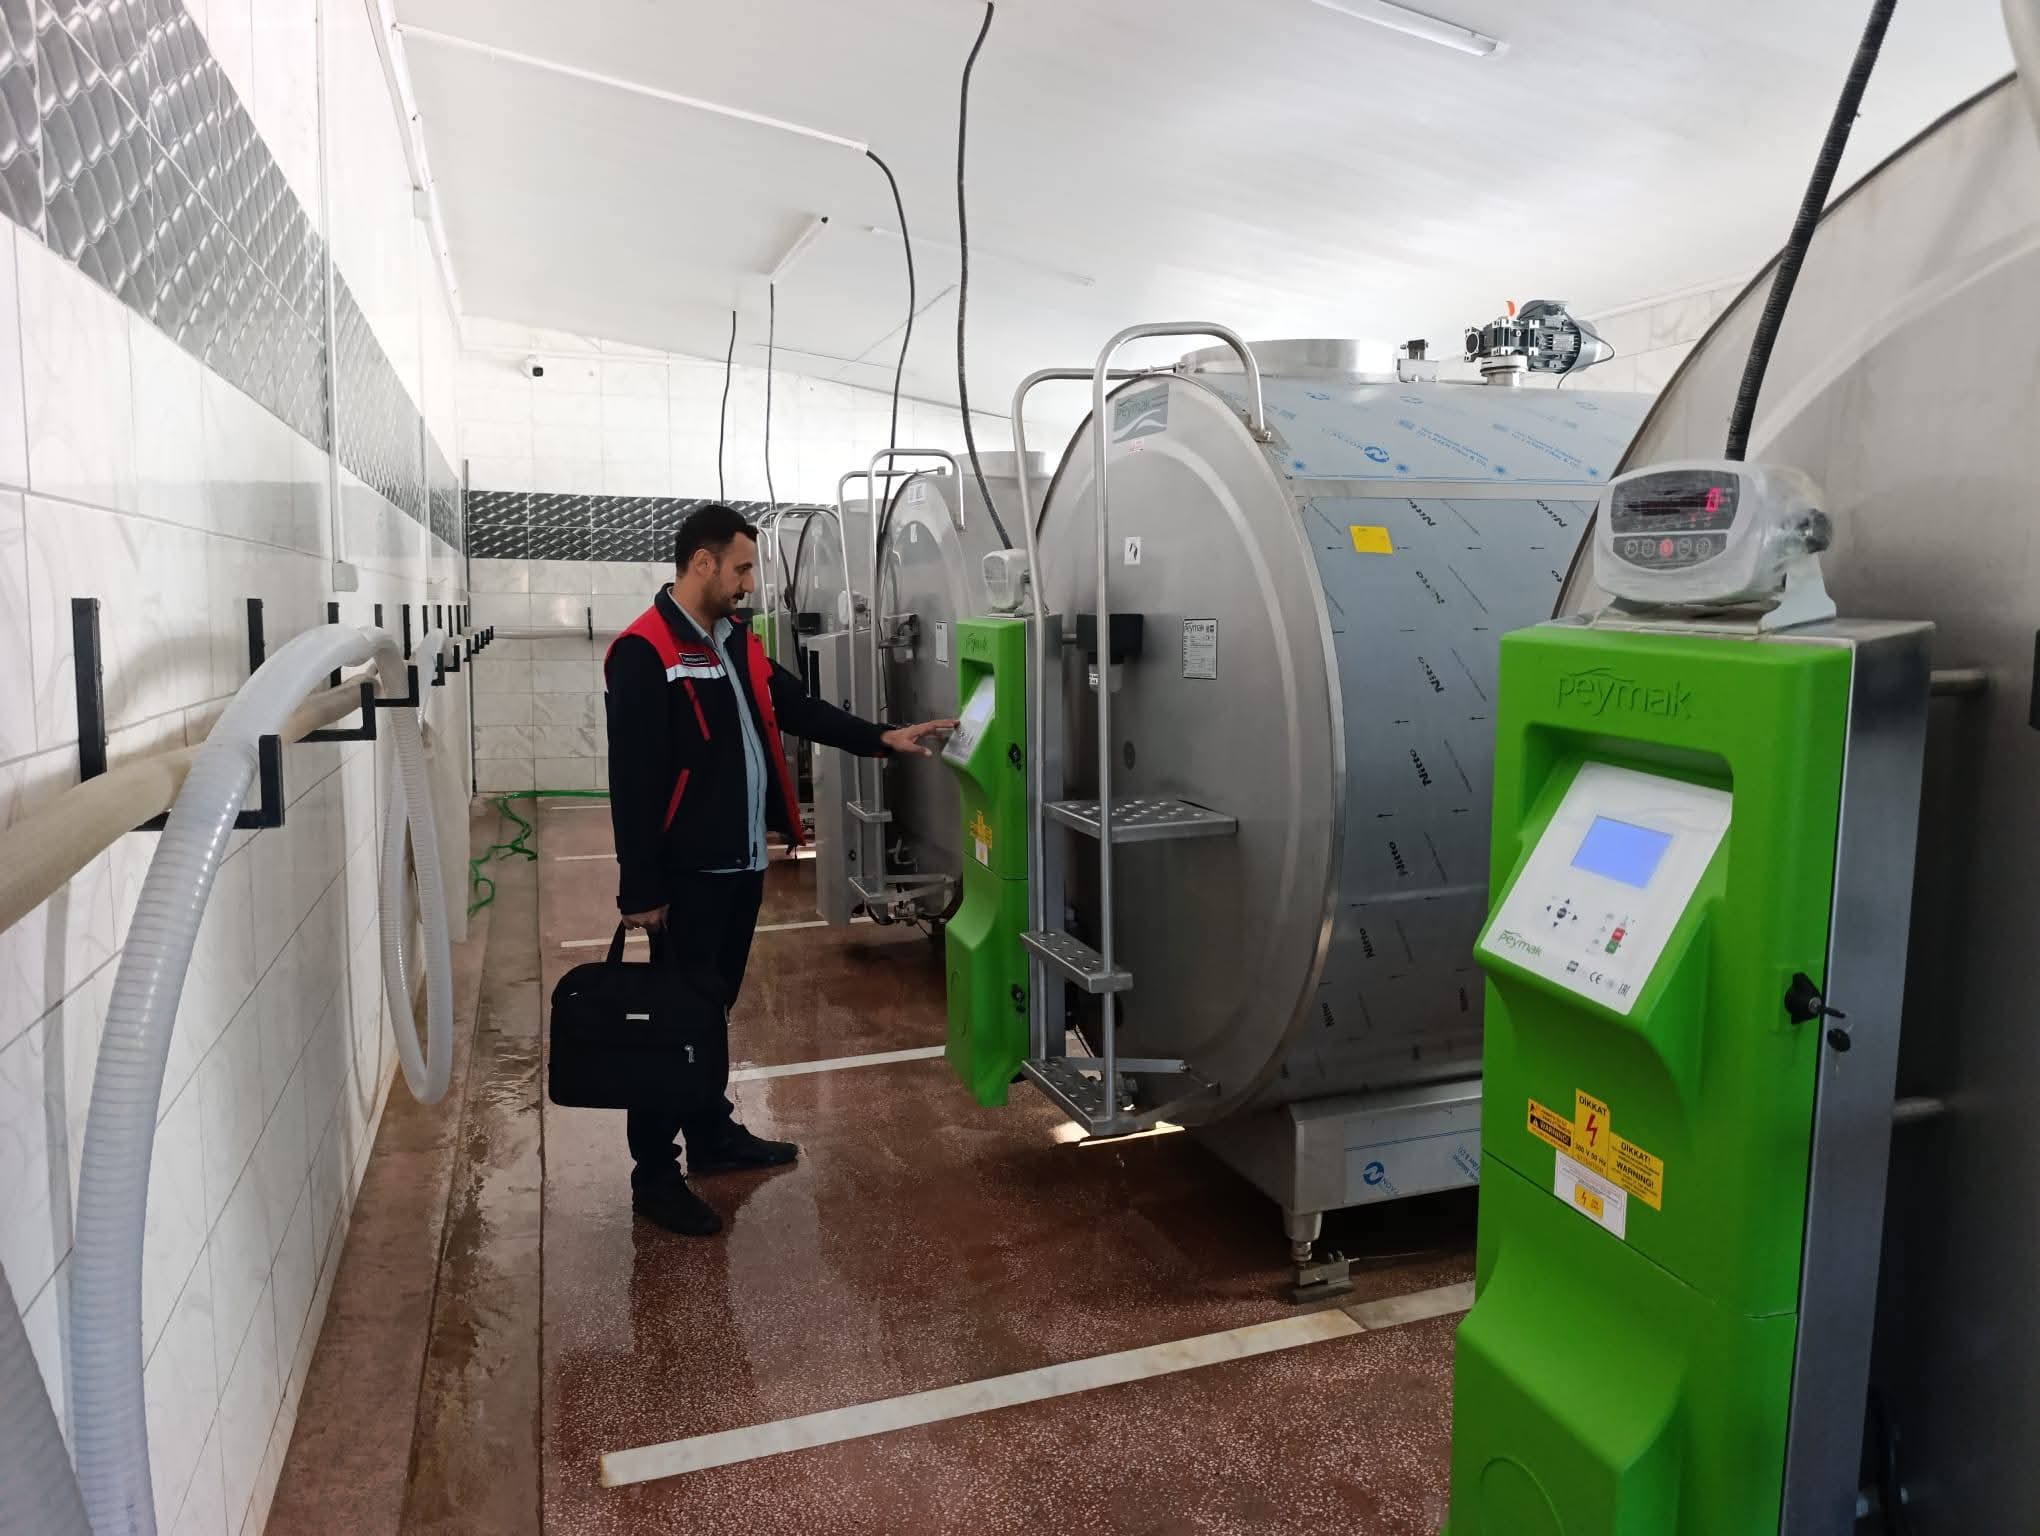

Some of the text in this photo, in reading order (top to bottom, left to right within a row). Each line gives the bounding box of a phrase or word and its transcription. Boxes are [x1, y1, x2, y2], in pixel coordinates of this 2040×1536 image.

[1557, 676, 1694, 720] peymak
[1409, 749, 1432, 788] Nitto
[1497, 931, 1544, 957] peymak
[1616, 1160, 1654, 1190] WARNING!
